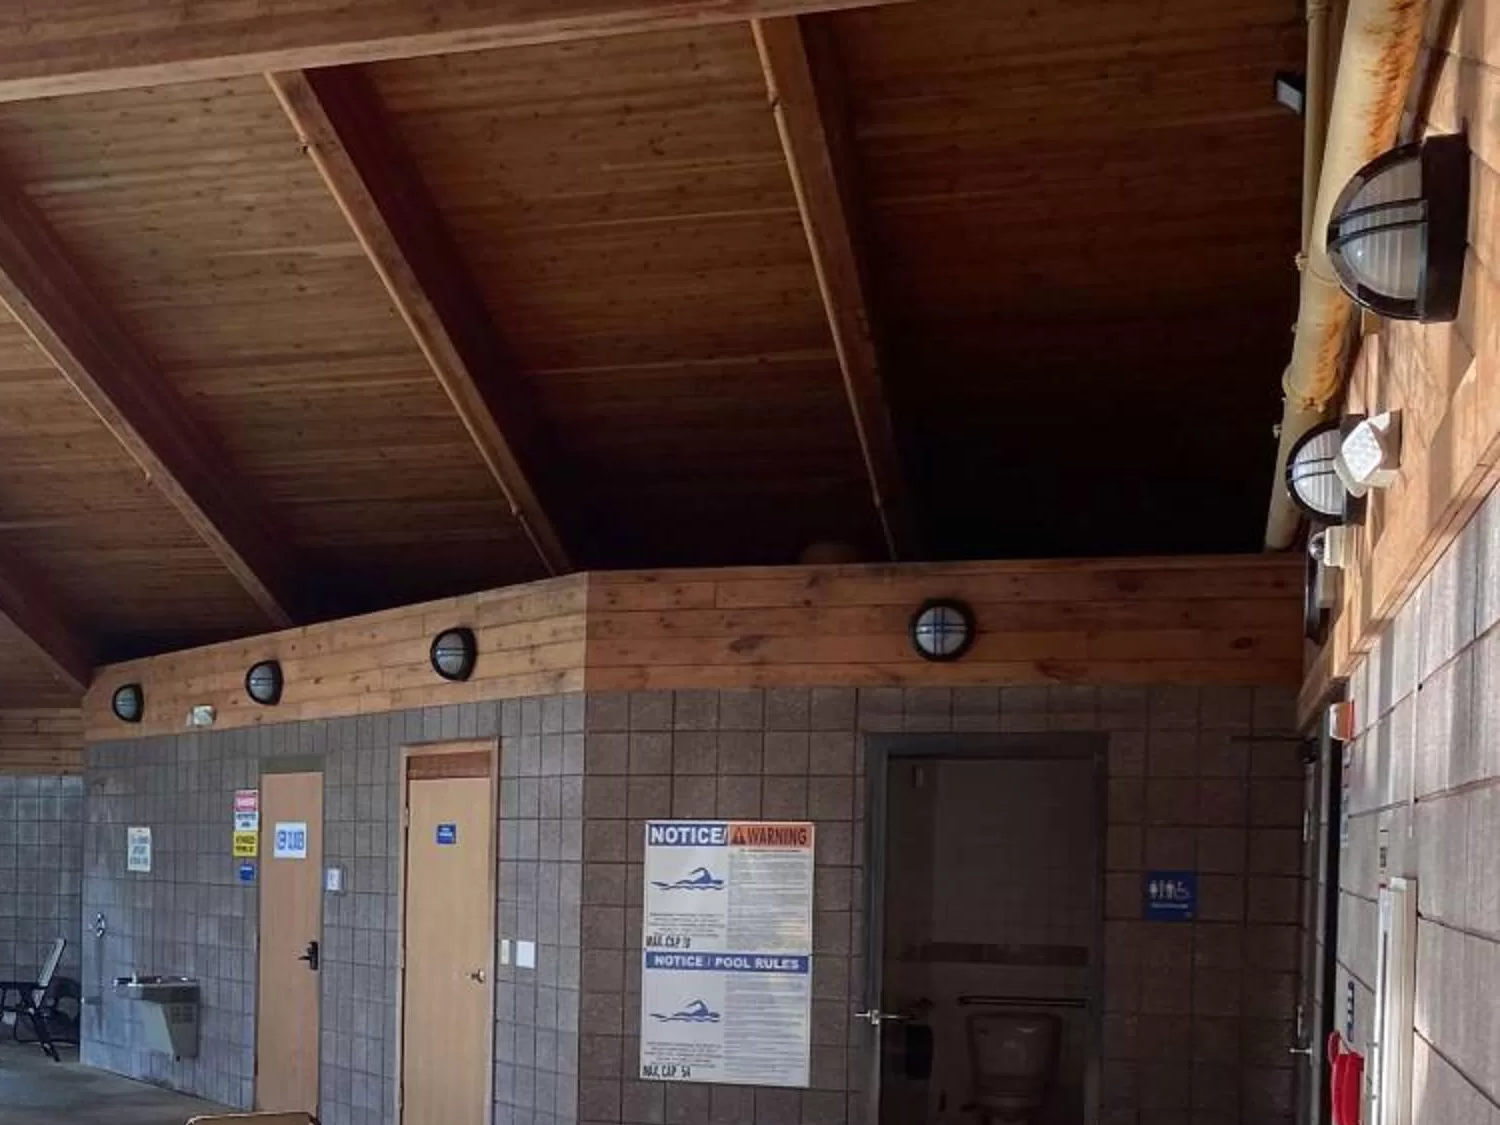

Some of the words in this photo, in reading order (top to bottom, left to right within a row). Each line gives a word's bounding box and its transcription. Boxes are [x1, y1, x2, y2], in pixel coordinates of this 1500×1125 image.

[651, 826, 724, 845] NOTICE
[747, 827, 807, 845] WARNING
[654, 955, 703, 967] NOTICE
[715, 957, 750, 969] POOL
[755, 958, 799, 970] RULES
